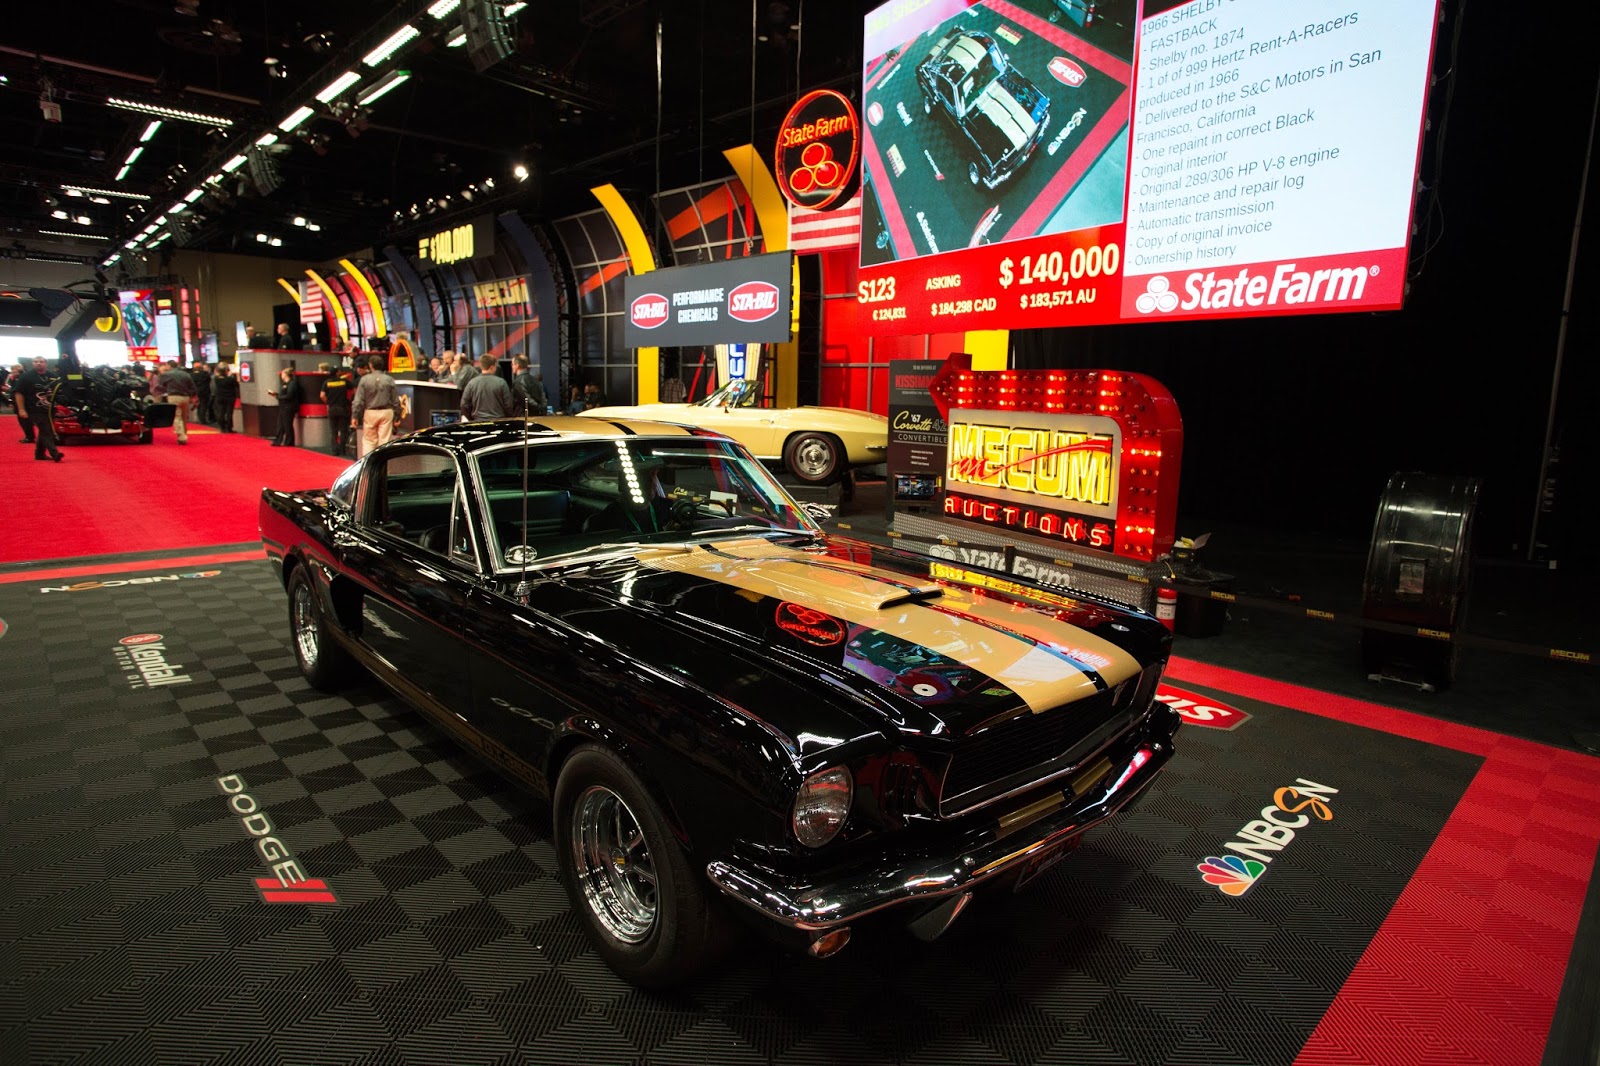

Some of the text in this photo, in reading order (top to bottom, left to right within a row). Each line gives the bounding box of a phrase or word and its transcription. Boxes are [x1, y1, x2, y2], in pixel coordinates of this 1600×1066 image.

[1142, 16, 1168, 36] 1966
[1150, 17, 1218, 53] FASTBACK
[1147, 11, 1359, 89] 1 of of 999 Hertz Rent-A-Racers
[1149, 27, 1245, 72] Shelby no. 1874
[1139, 68, 1240, 110] produced in 1966
[1145, 49, 1382, 126] Delivered to the S&C Motors in San
[1136, 104, 1256, 145] Francisco, California
[1142, 108, 1315, 161] One repaint in correct Black
[1140, 146, 1340, 198] Original 289/306 HP V-8 engine
[1141, 150, 1228, 179] Original interior
[1138, 173, 1305, 215] Maintenance and repair log
[1137, 200, 1275, 231] Automatic transmission
[1136, 219, 1273, 252] Copy of original invoice
[1134, 243, 1237, 267] Ownership history
[672, 287, 725, 308] PERFORMANCE
[731, 290, 777, 312] STA-BIL
[858, 274, 961, 304] S123 ASKING
[1076, 288, 1096, 305] AU
[633, 302, 668, 320] STA-BIL
[677, 307, 719, 324] CHEMICALS
[973, 297, 997, 312] CAD
[893, 410, 932, 431] Corvette
[898, 433, 948, 444] CONVERTIBLE
[948, 423, 1113, 506] MECUM
[944, 496, 1108, 548] AUCTIONS
[1012, 555, 1071, 587] Farm
[1210, 591, 1236, 601] MECUM
[1306, 608, 1334, 619] MECUM
[1417, 627, 1450, 639] MECUM
[112, 646, 135, 670] MOTOR
[127, 642, 192, 687] Kendall
[1550, 648, 1590, 661] MECUM
[127, 674, 145, 689] OIL
[218, 774, 306, 889] DODGE
[1224, 777, 1339, 863] NBCSN
